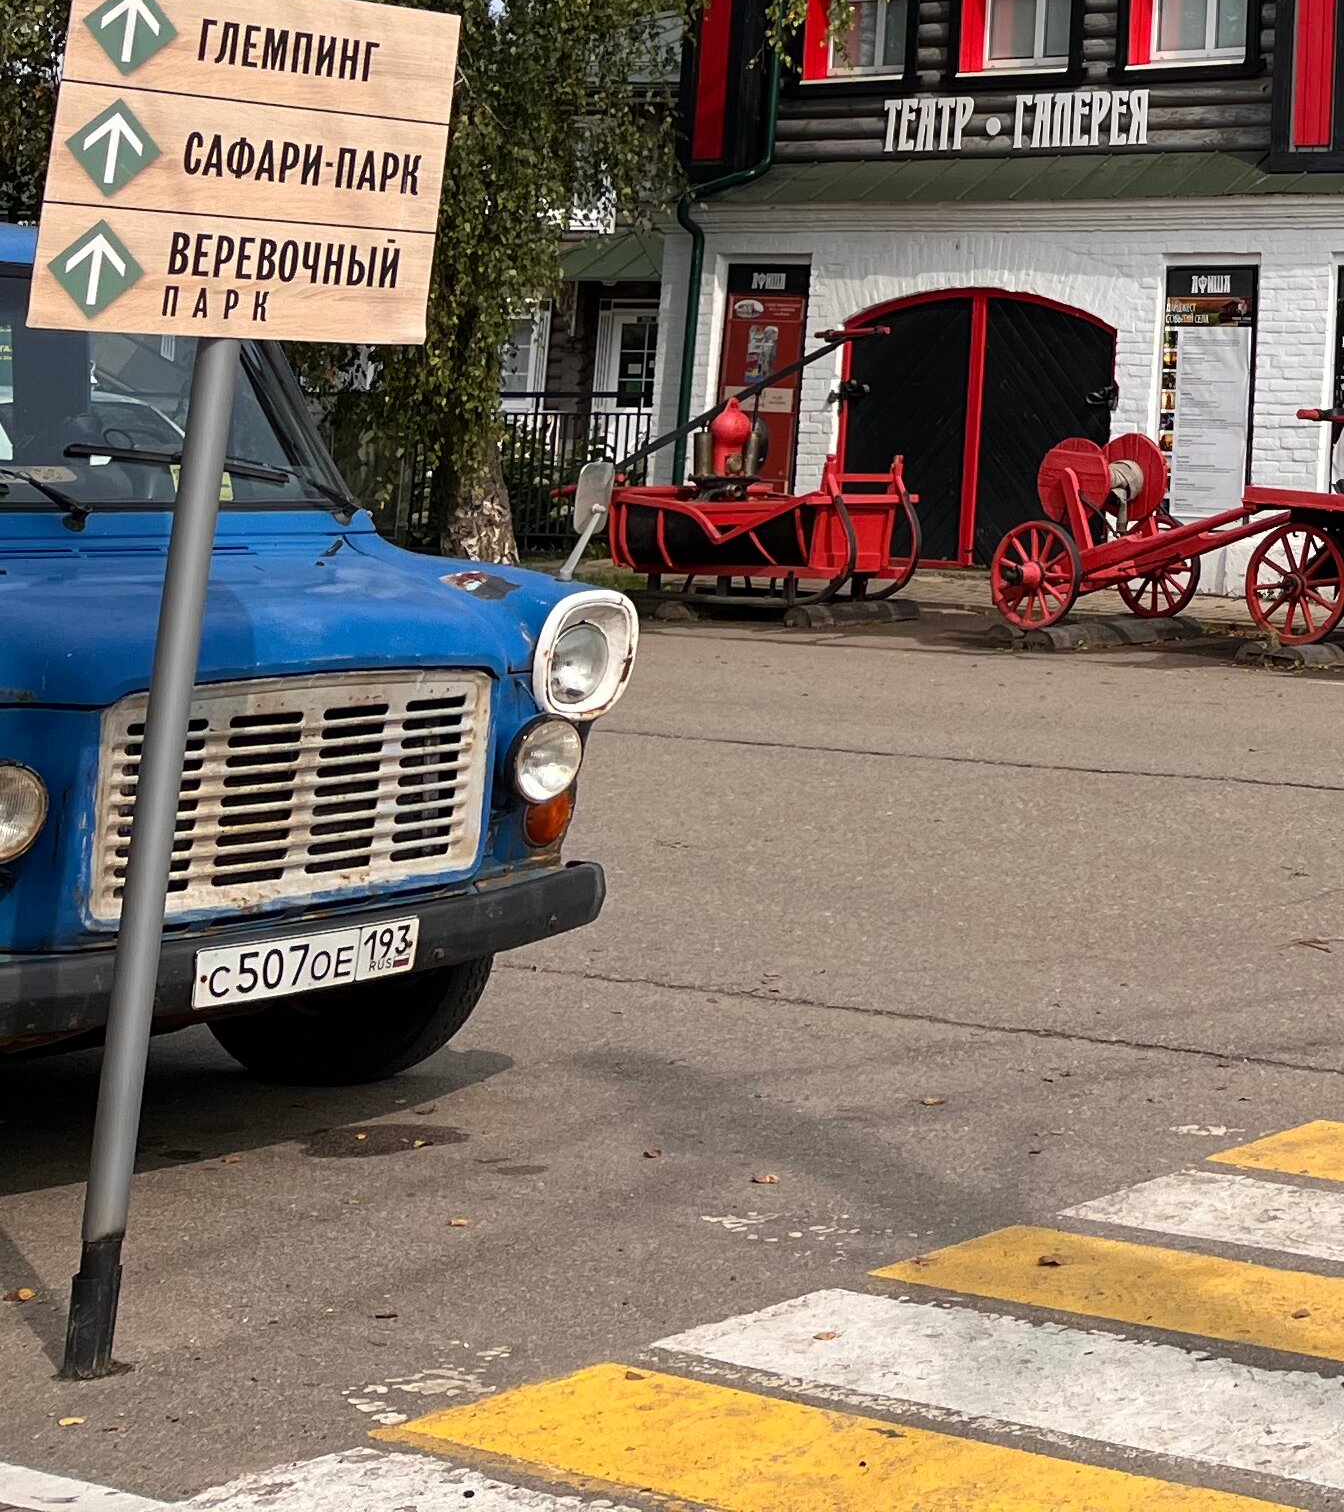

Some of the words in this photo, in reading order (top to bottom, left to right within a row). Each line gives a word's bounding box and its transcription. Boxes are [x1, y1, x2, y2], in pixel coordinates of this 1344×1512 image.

[196, 18, 381, 82] ГЛЕМПИНГ
[883, 96, 975, 152] ТЕАТР
[1013, 89, 1150, 149] ГАЛЕРЕЯ
[183, 130, 423, 196] САФАРИ-ПАРК
[168, 230, 401, 288] ВЕРЕВОЧНЫЙ
[161, 286, 271, 322] ПАРК
[1190, 274, 1231, 294] АФИША
[363, 924, 412, 962] 193
[368, 957, 392, 973] RUS
